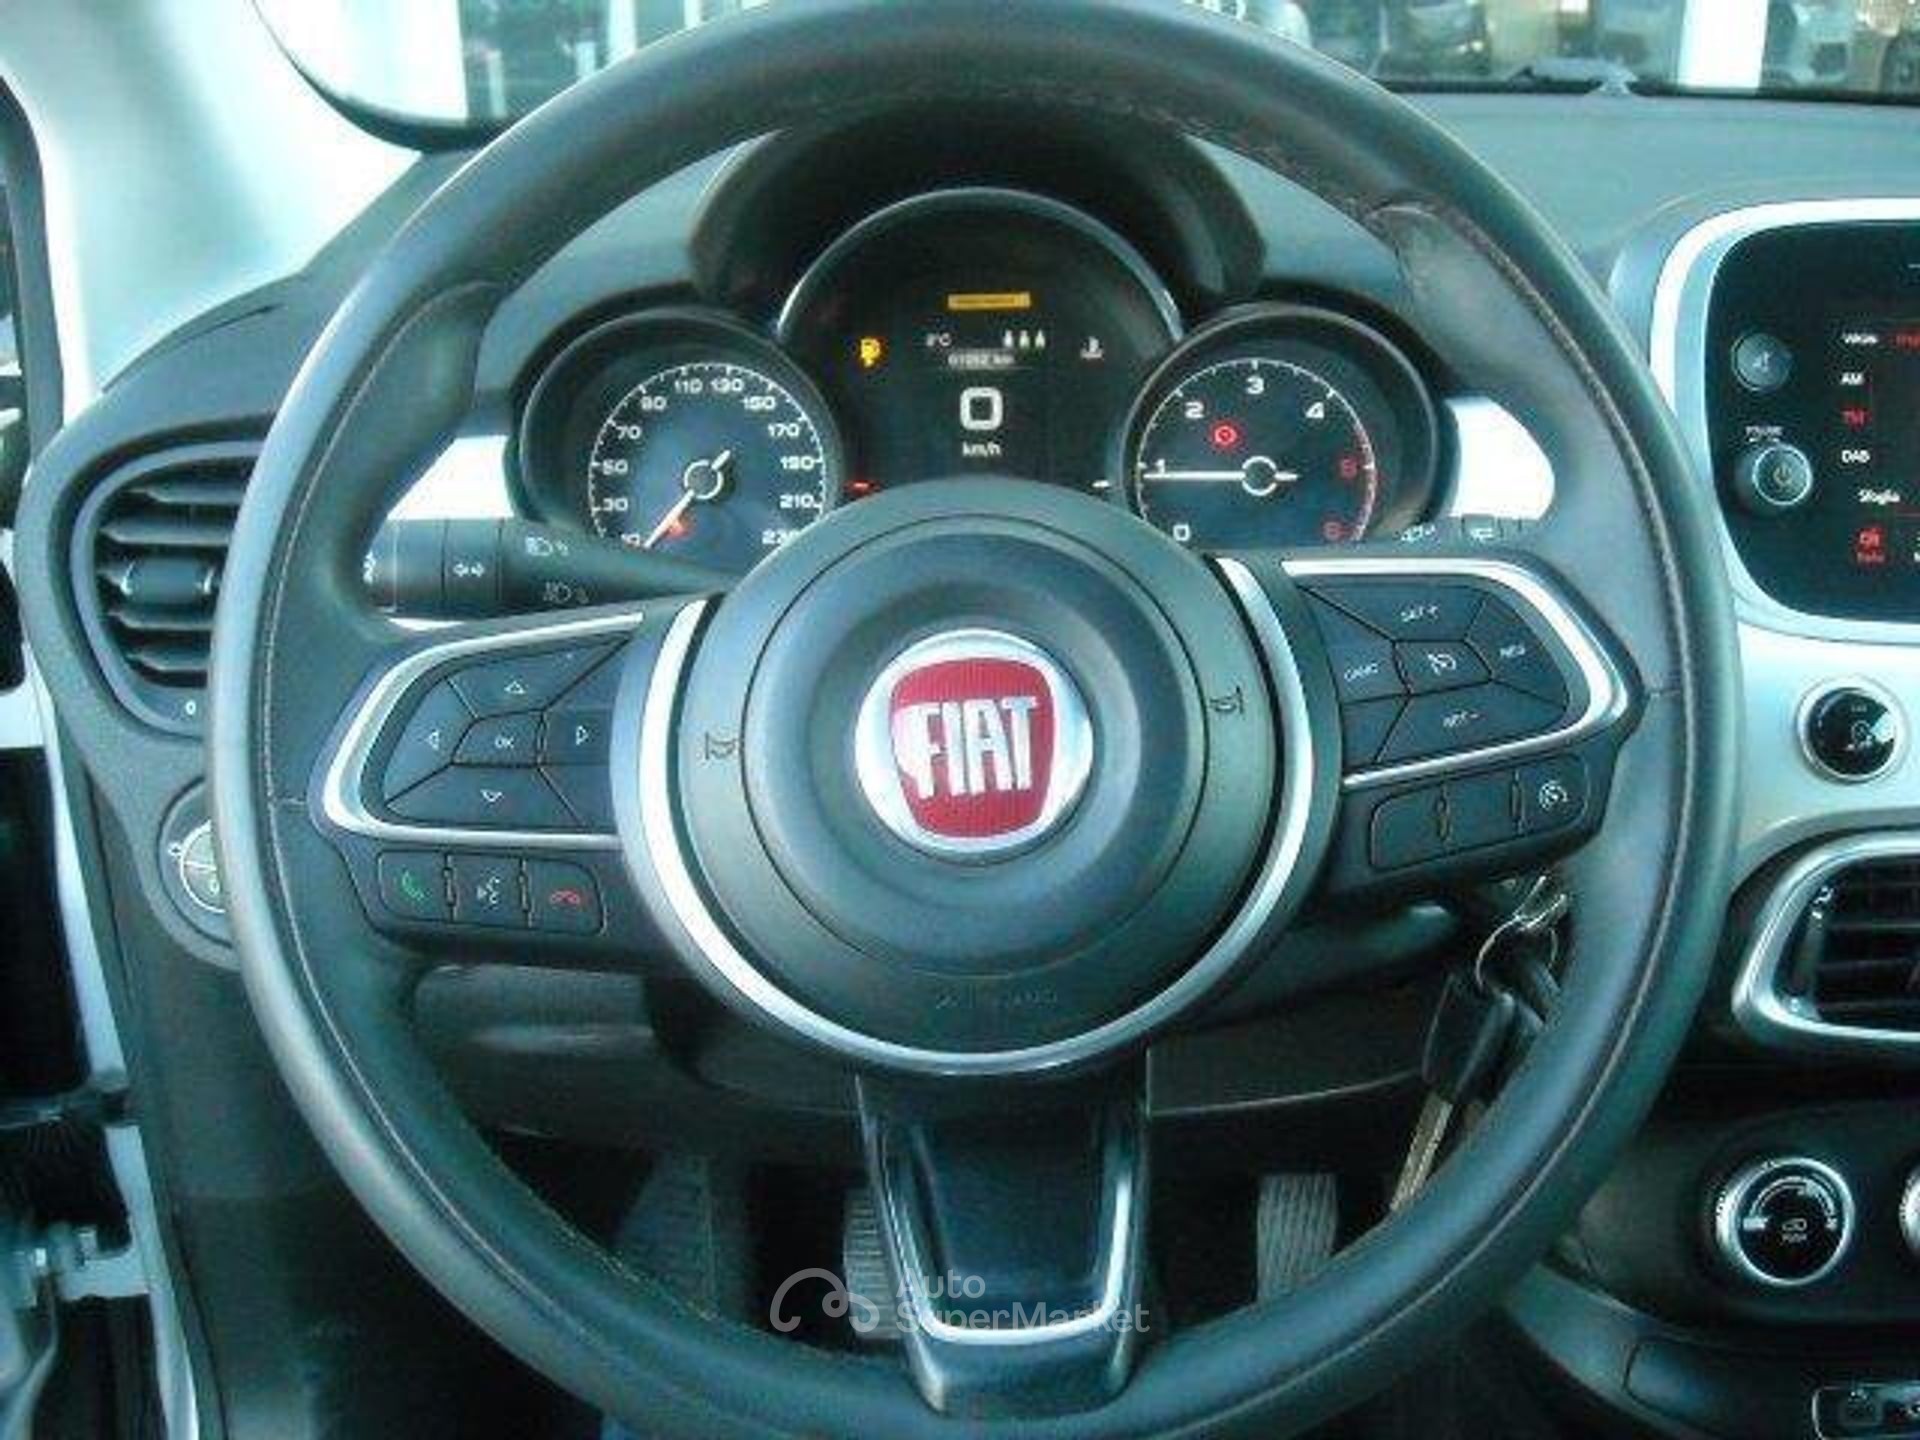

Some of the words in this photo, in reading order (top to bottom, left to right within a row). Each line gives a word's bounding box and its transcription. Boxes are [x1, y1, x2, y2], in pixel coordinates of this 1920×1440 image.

[674, 379, 704, 393] 110
[1246, 377, 1266, 396] 3
[959, 386, 1004, 431] 0
[1184, 401, 1205, 420] 2
[1305, 402, 1326, 420] 4
[616, 424, 642, 441] 70
[767, 423, 801, 439] 170
[603, 498, 629, 512] 30
[779, 494, 814, 510] 210
[1172, 523, 1193, 542] 0
[898, 696, 1037, 800] FIAT
